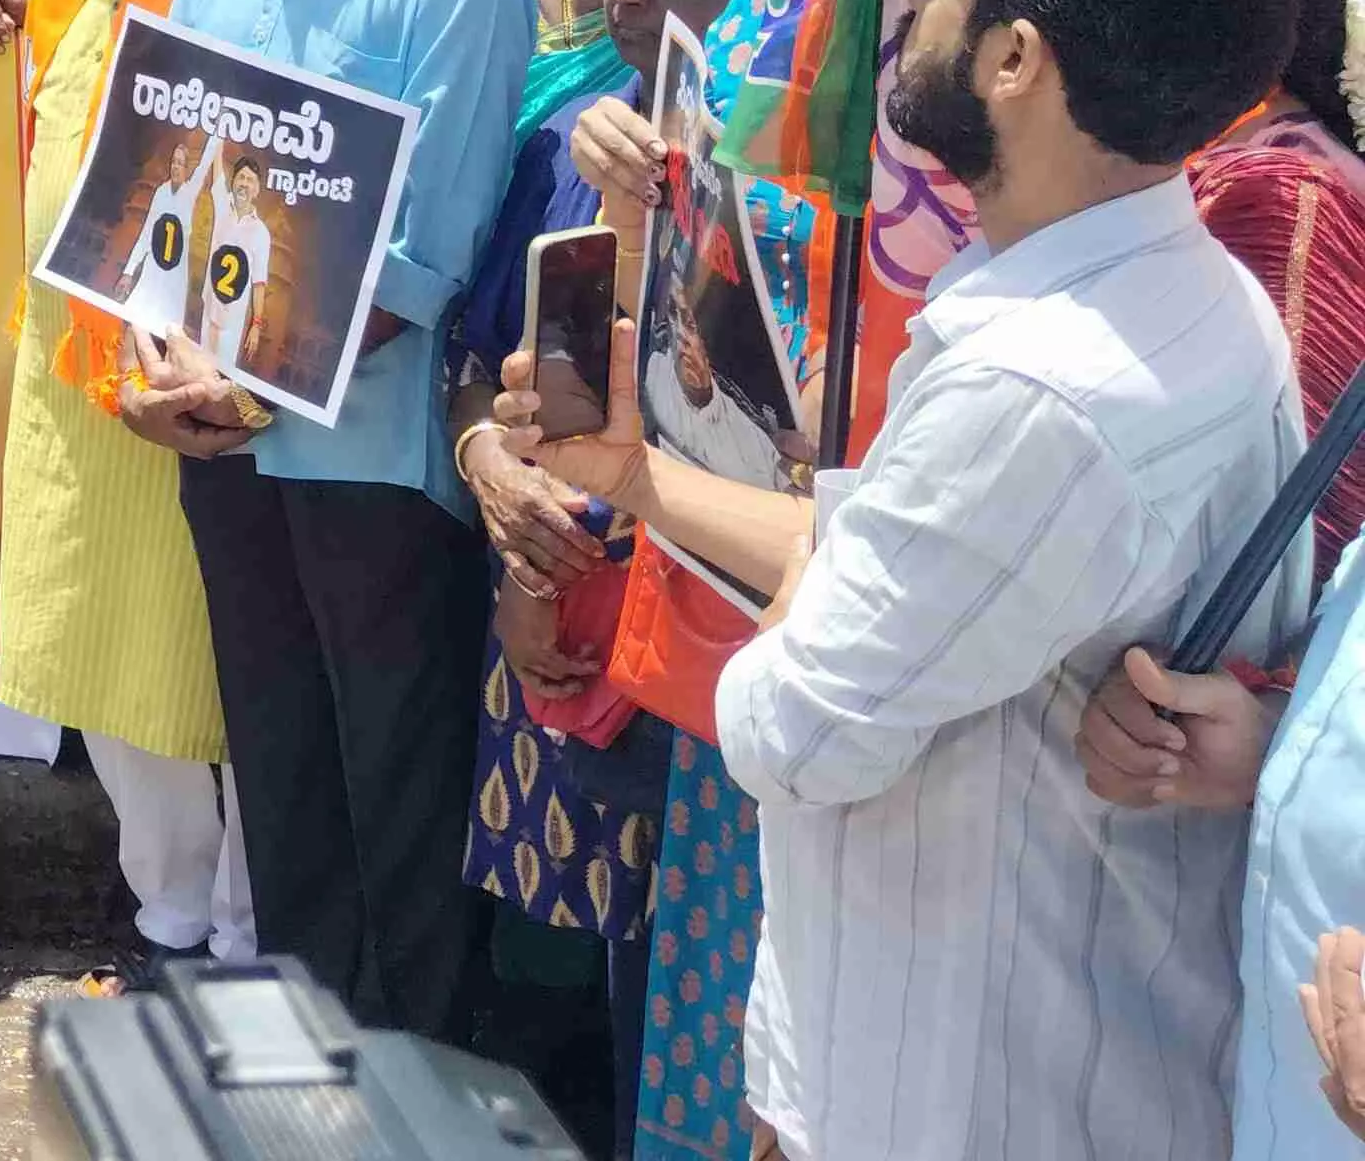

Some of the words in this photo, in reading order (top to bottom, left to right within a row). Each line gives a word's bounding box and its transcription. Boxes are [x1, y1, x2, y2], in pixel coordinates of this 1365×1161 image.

[132, 71, 337, 165] ರಾಜೀನಾಮೆ
[266, 165, 355, 206] ಗ್ಯಾರಂಟಿ
[214, 253, 240, 296] 2
